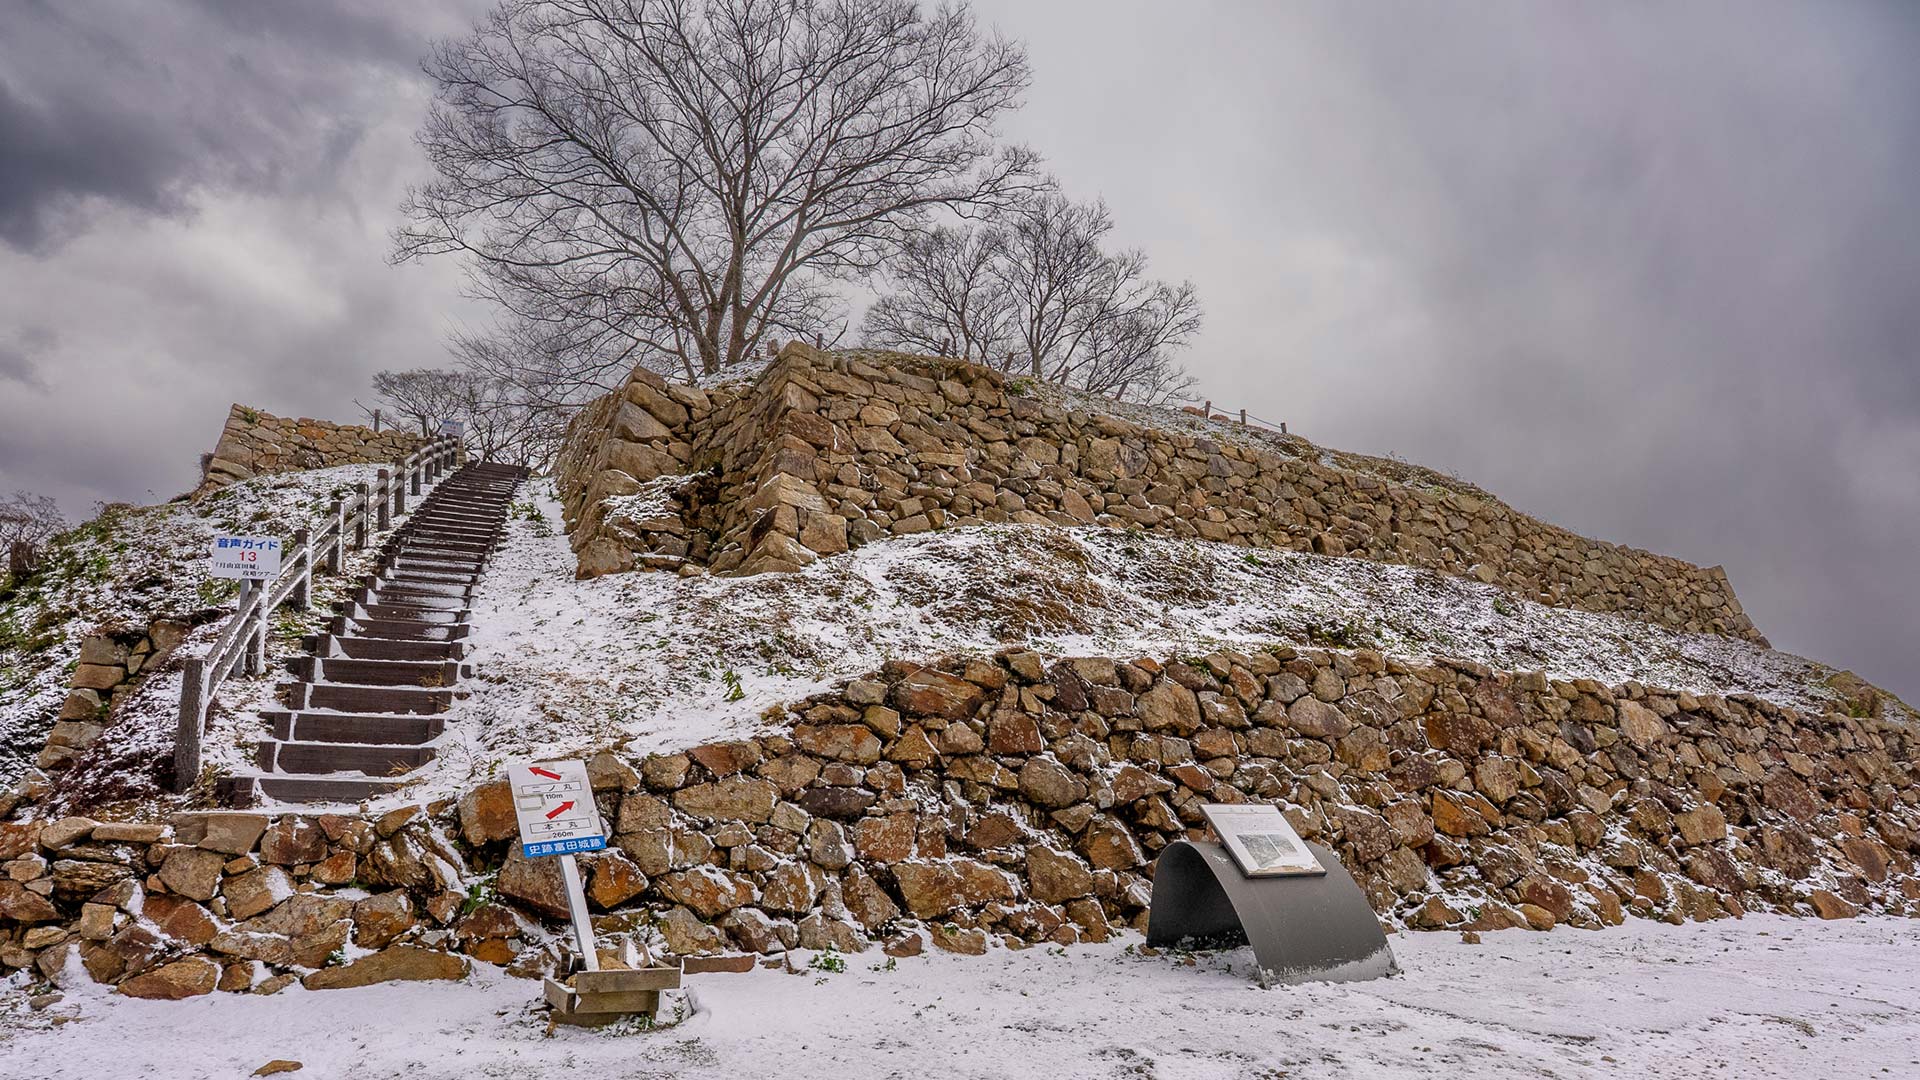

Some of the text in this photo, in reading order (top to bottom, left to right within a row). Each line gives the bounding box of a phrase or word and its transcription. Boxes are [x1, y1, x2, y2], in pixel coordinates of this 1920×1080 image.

[217, 538, 278, 550] 音声ガイド
[240, 551, 257, 561] 13
[529, 838, 601, 855] 史跡富田城跡
